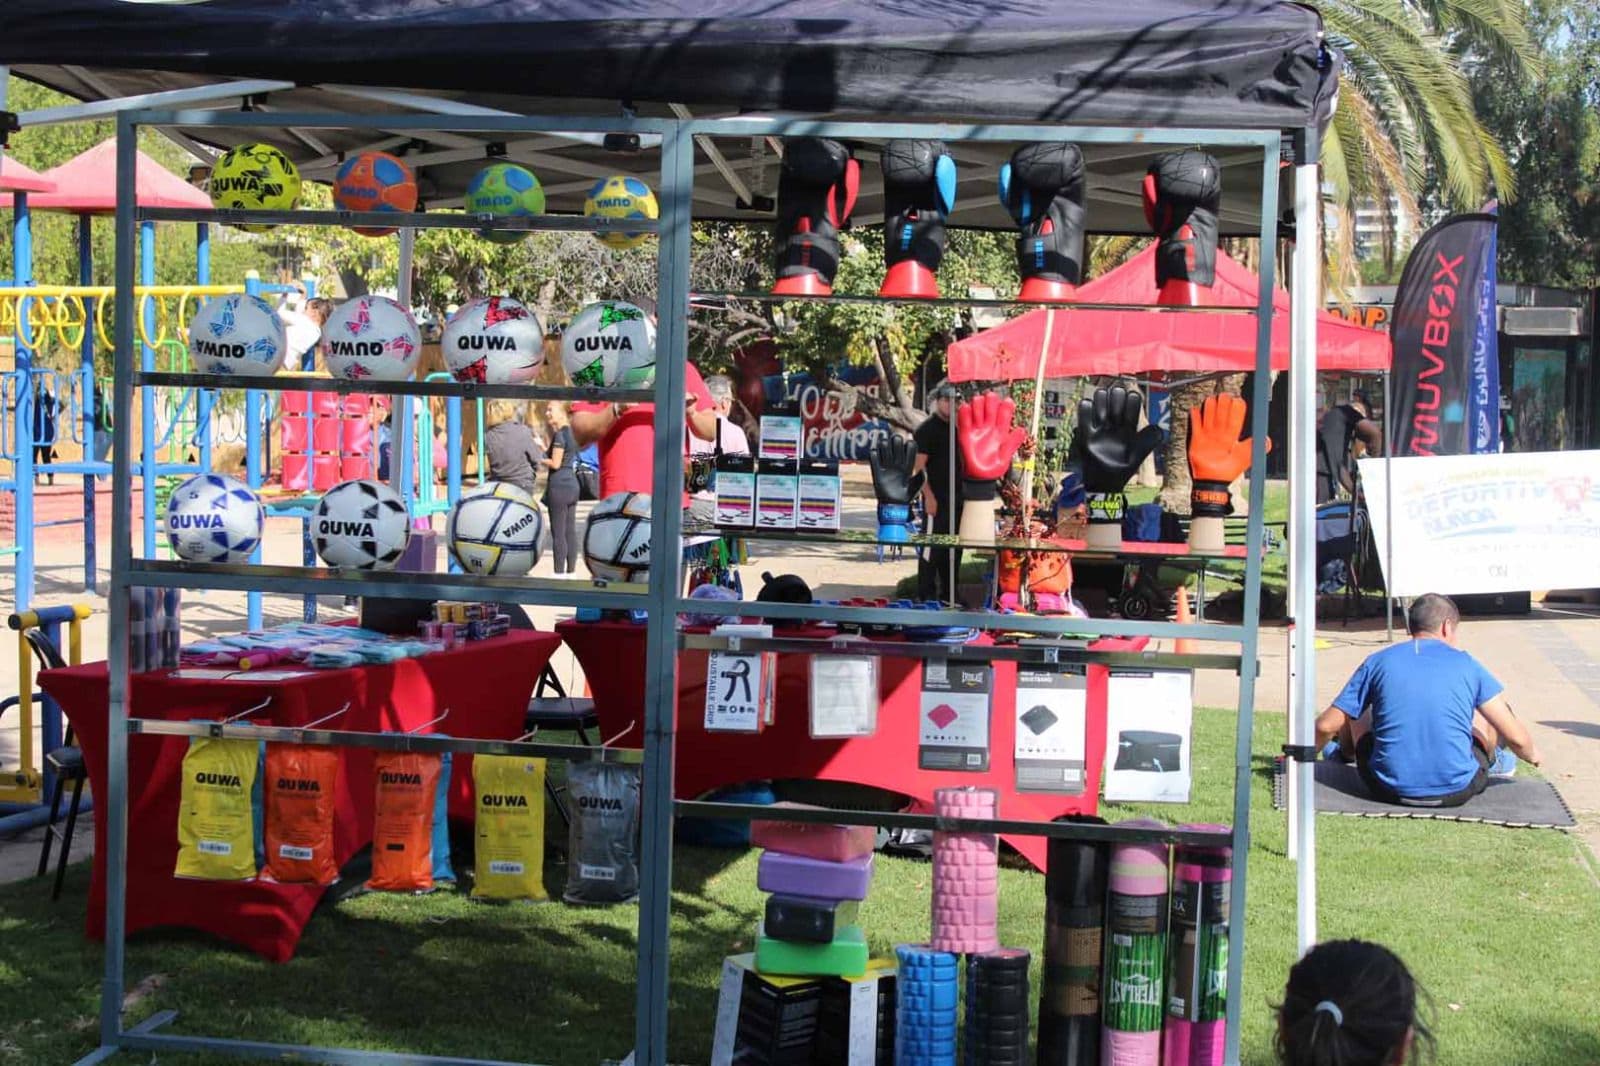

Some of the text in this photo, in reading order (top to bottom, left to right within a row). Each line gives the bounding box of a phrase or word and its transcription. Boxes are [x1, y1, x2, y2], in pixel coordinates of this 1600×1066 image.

[195, 338, 246, 359] QUWA
[330, 340, 384, 357] QUWA
[458, 335, 517, 351] QUWA
[574, 336, 633, 352] QUWA
[1410, 251, 1465, 456] MUVBOX
[170, 514, 225, 530] QUWA
[319, 520, 376, 538] QUWA
[502, 513, 534, 538] QUWA
[195, 772, 241, 787] QUWA
[277, 778, 321, 791] QUWA
[381, 772, 422, 785] QUWA
[482, 794, 528, 807] QUWA
[579, 796, 623, 811] QUWA
